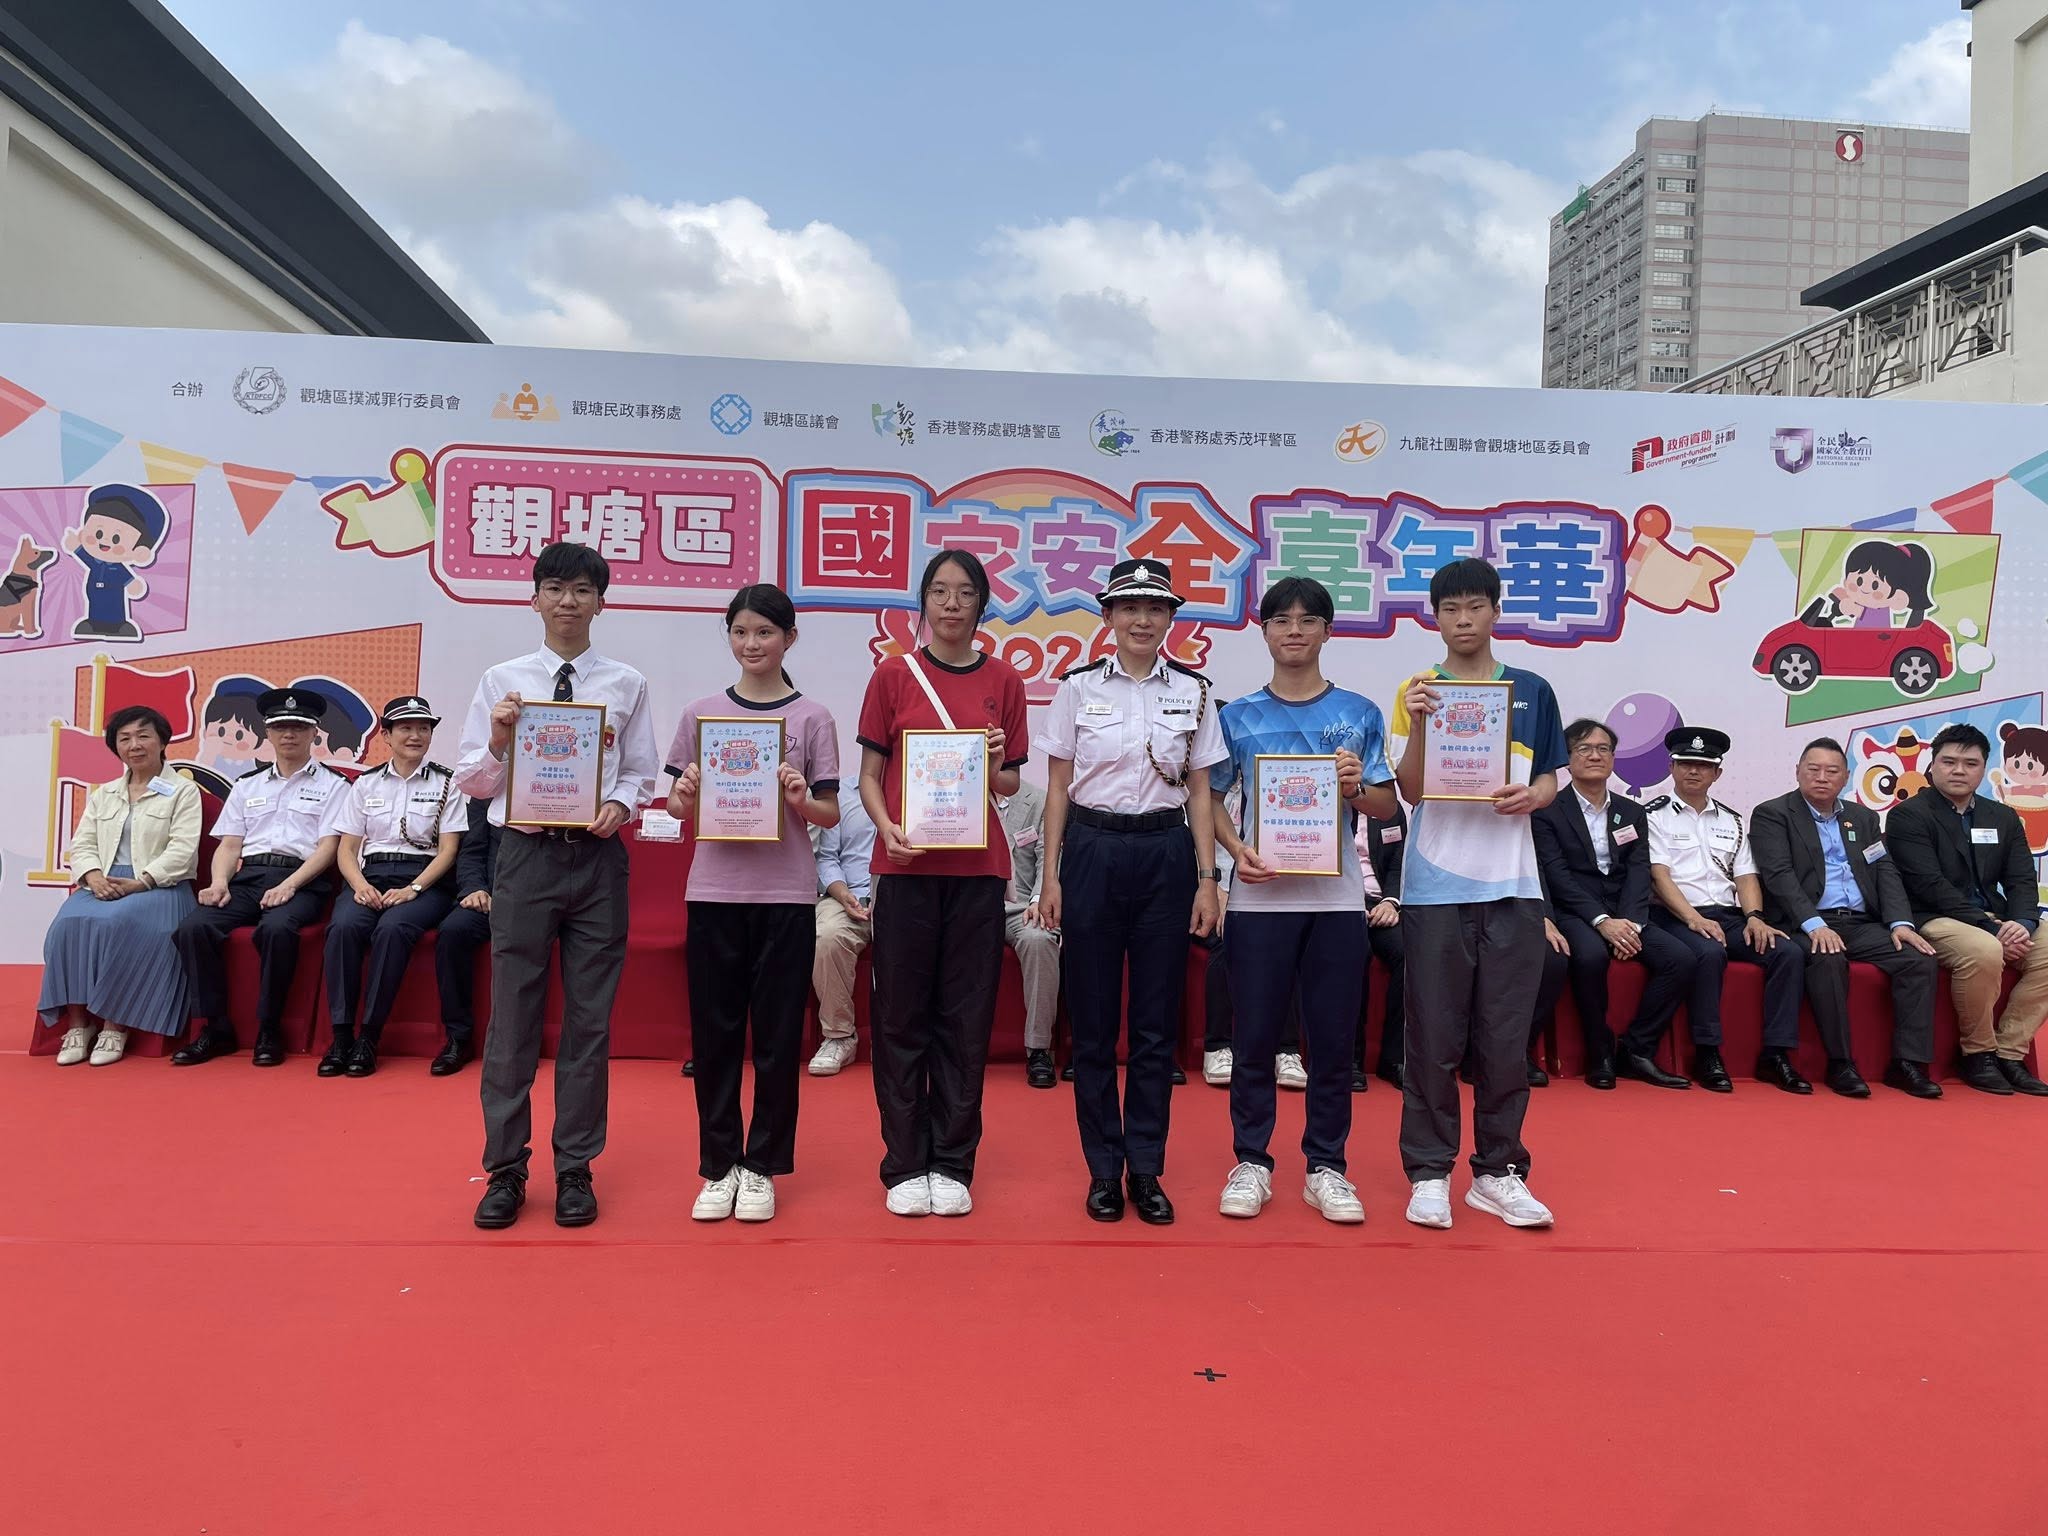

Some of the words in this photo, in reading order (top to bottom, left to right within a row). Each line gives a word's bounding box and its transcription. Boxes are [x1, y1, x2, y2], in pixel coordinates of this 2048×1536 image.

[172, 382, 203, 397] 合辦
[300, 388, 461, 411] 觀塘區撲滅罪行委員會
[572, 400, 682, 421] 觀塘民政事務處
[763, 411, 839, 430] 觀塘區議會
[927, 420, 1061, 440] 香港警務處觀塘警區
[1150, 429, 1297, 447] 香港警務處秀茂坪警區
[1400, 436, 1591, 456] 九龍社團聯會觀塘地區委員會
[1816, 446, 1872, 456] 國家安全教育日
[1646, 445, 1712, 468] Government-funded
[1681, 452, 1717, 467] programme
[470, 485, 733, 566] 觀塘區
[802, 489, 1242, 605] 國家安全
[1266, 509, 1605, 622] 嘉年華
